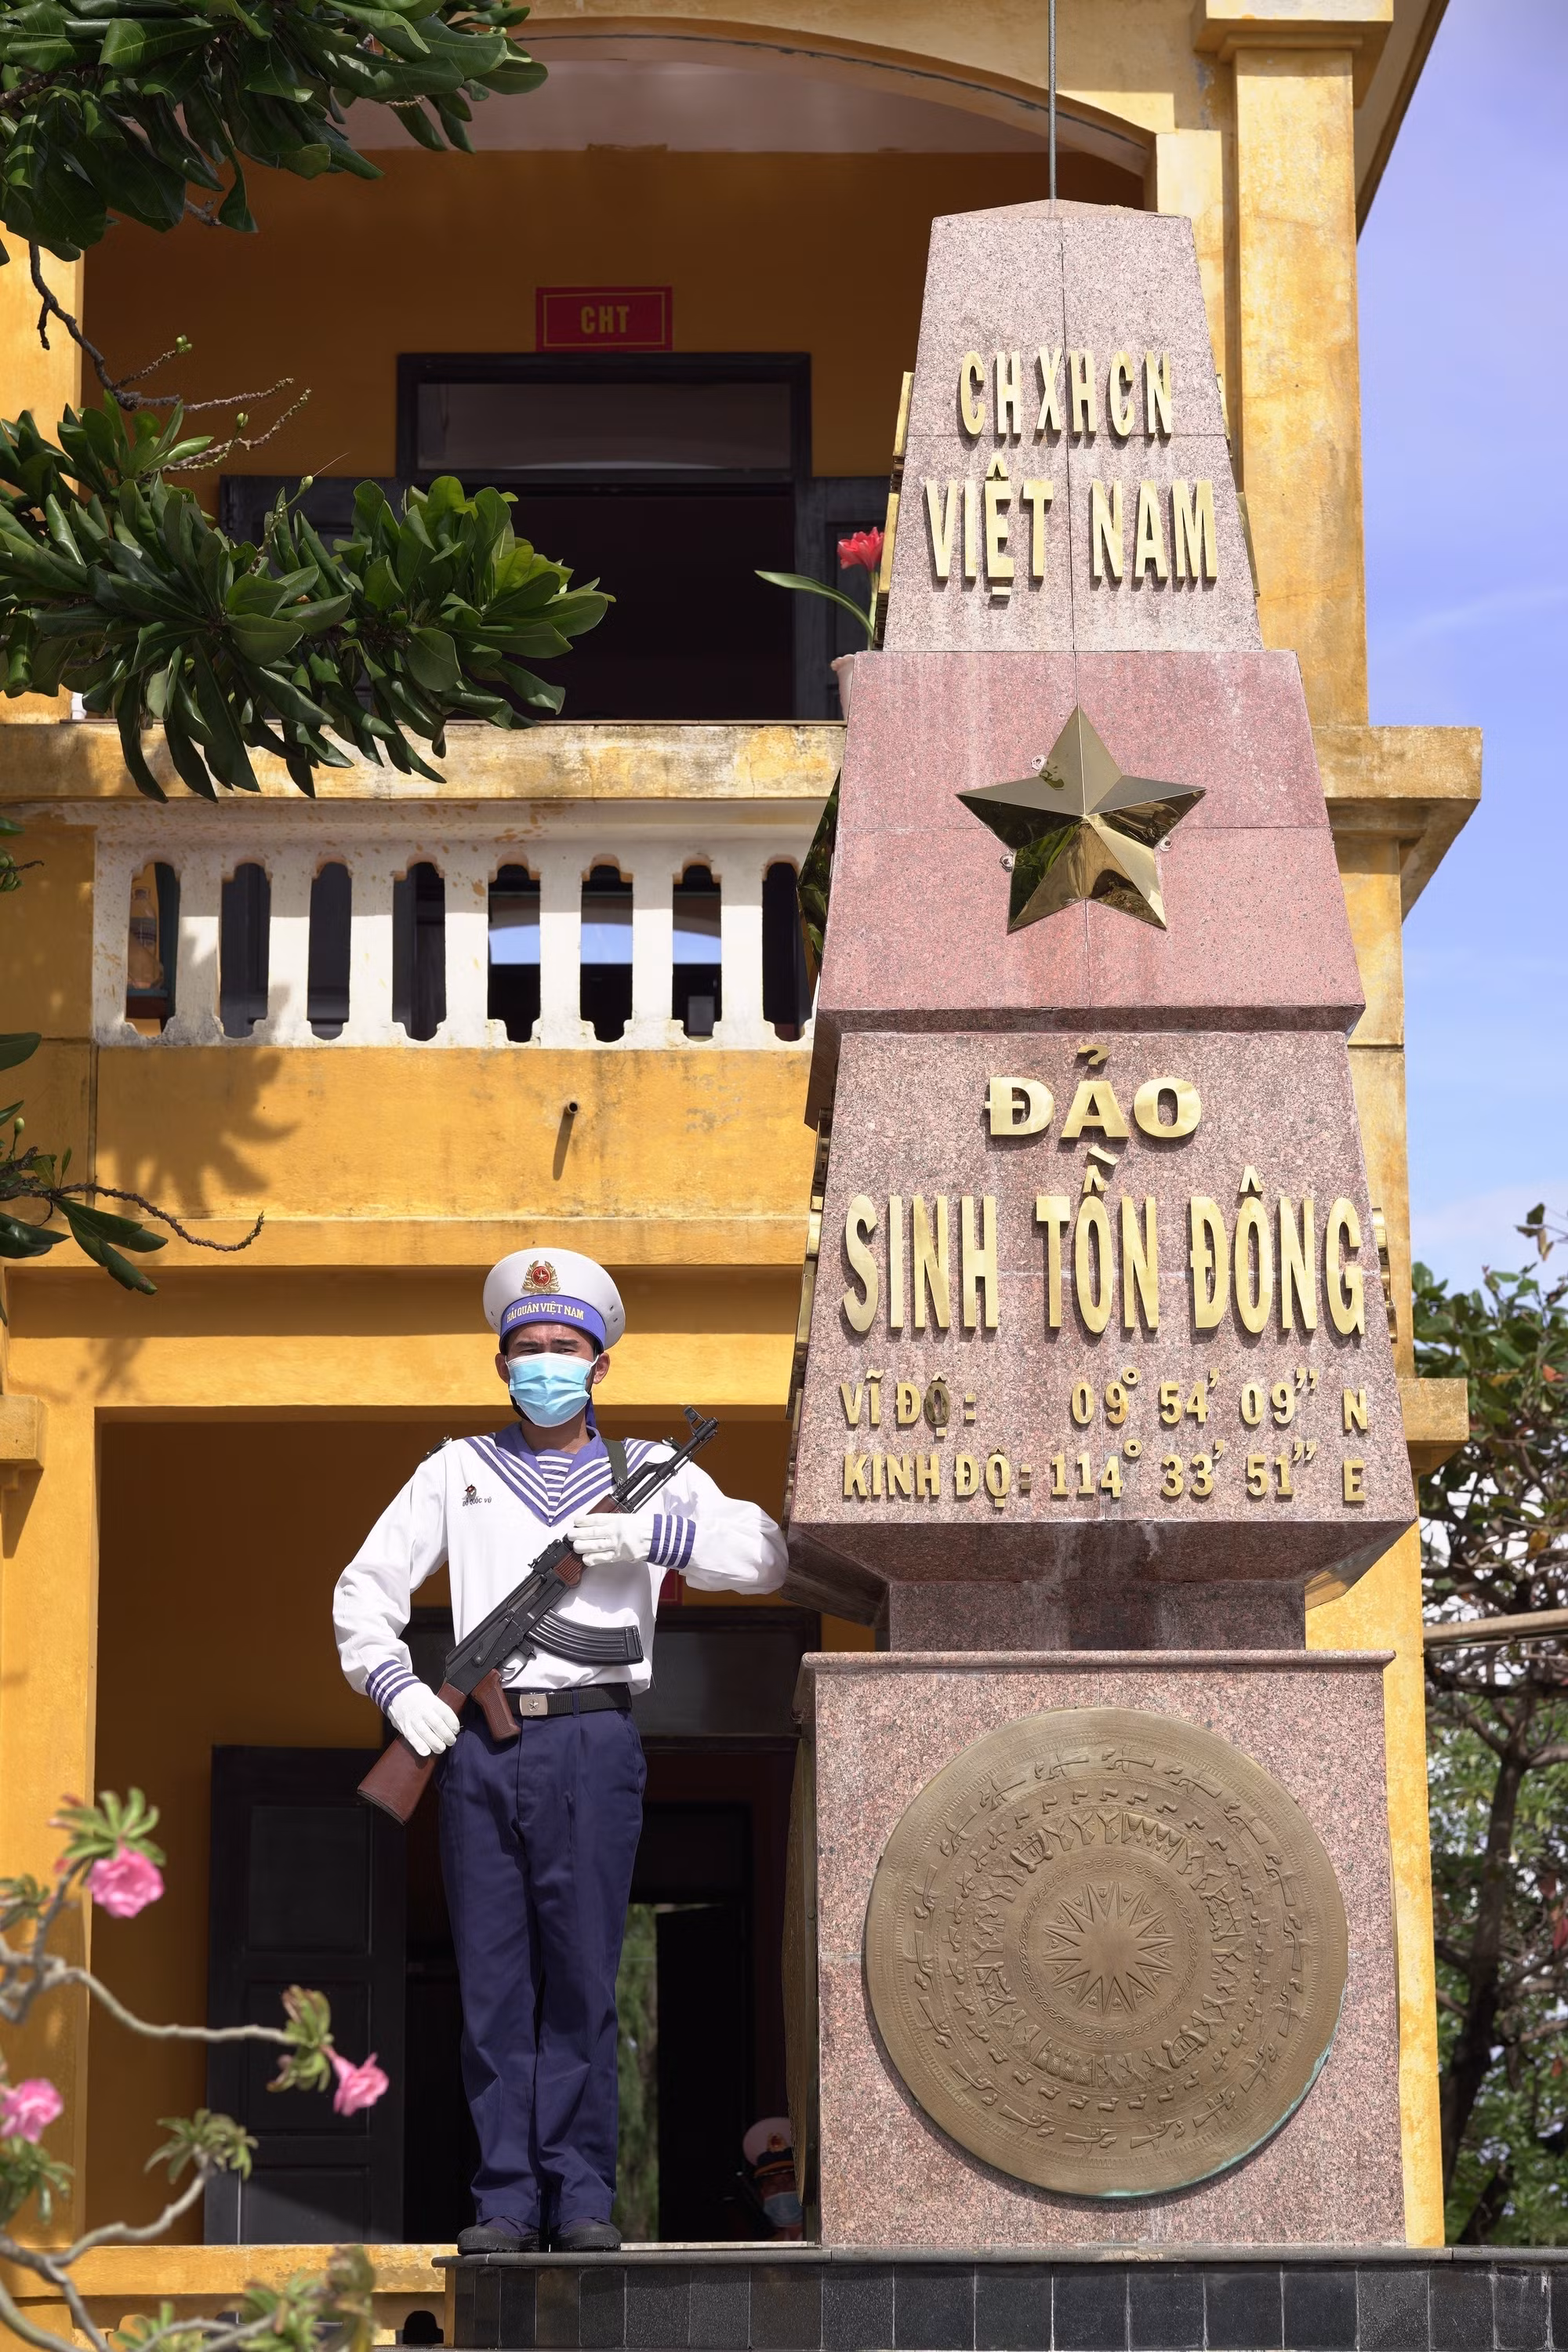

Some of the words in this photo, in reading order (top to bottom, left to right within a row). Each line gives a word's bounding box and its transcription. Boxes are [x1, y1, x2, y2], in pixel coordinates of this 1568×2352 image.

[580, 305, 630, 334] CHT
[960, 347, 1171, 437] CHXHCN
[926, 452, 1054, 597] VIỆT
[1092, 479, 1217, 579] NAM
[985, 1045, 1202, 1138] ĐẢO
[842, 1194, 998, 1333] SINH
[1035, 1145, 1159, 1334] TỒN
[1189, 1165, 1366, 1335] ĐÔNG
[517, 1301, 539, 1316] QUÂN
[539, 1301, 563, 1315] VIỆT
[564, 1305, 584, 1320] NAM
[840, 1368, 884, 1425] VĨ
[1343, 1388, 1368, 1430] N
[844, 1454, 940, 1496] KINH
[1344, 1460, 1366, 1501] E
